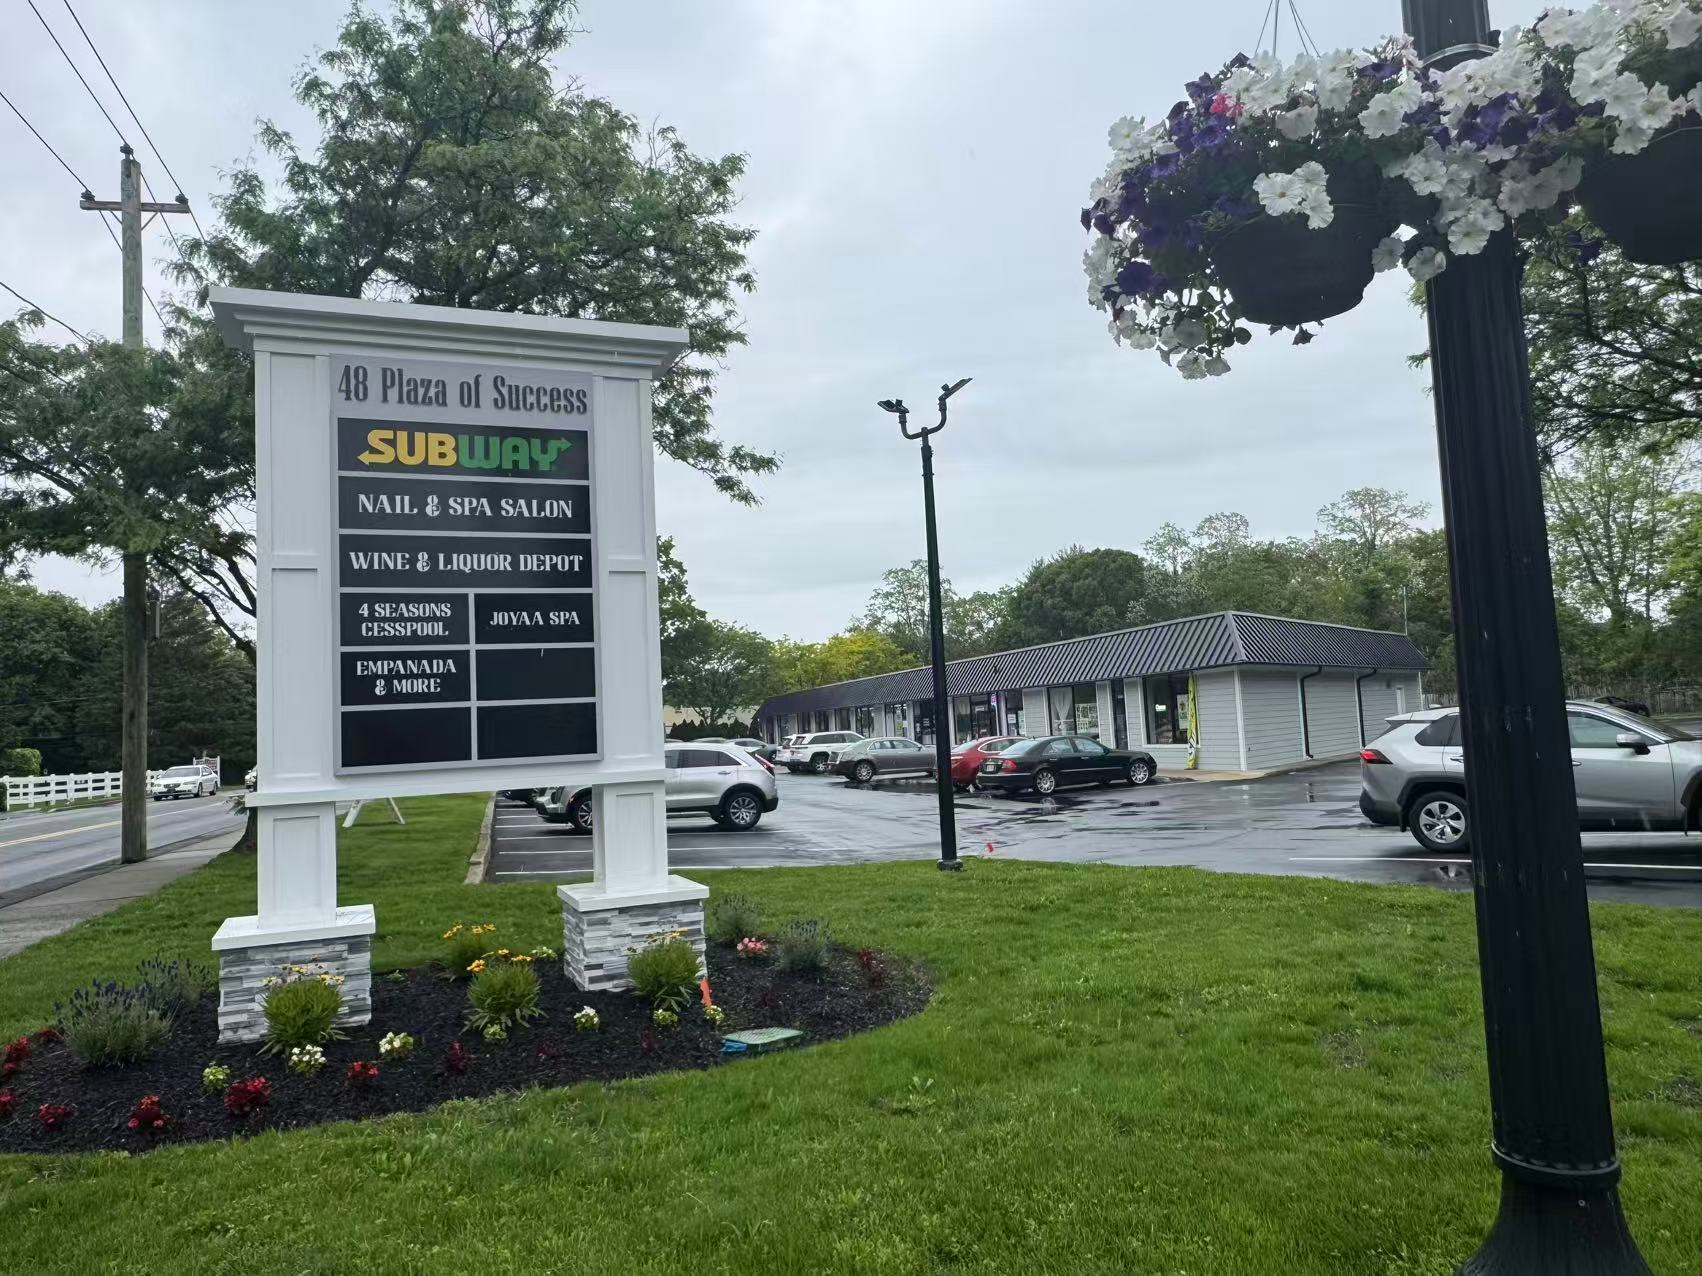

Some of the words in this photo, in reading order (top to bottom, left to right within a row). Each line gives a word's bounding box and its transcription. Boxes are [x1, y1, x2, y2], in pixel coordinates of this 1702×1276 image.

[338, 365, 368, 402] 48
[381, 368, 448, 407] Plaza
[460, 374, 482, 408] of
[493, 375, 587, 415] Success
[357, 429, 572, 471] SUBWAY
[358, 494, 418, 514] NAIL
[426, 495, 441, 516] &
[449, 497, 492, 516] SPA
[501, 499, 572, 518] SALON
[349, 552, 409, 569] WINE
[417, 552, 430, 572] &
[439, 552, 512, 573] LIQUOR
[520, 555, 583, 571] DEPOT
[359, 603, 368, 617] 4
[375, 603, 451, 617] SEASONS
[490, 612, 543, 625] JOYAA
[550, 612, 579, 624] SPA
[362, 622, 448, 636] CESSPOOL
[357, 659, 456, 675] EMPANADA
[375, 679, 386, 695] &
[394, 679, 440, 693] MORE
